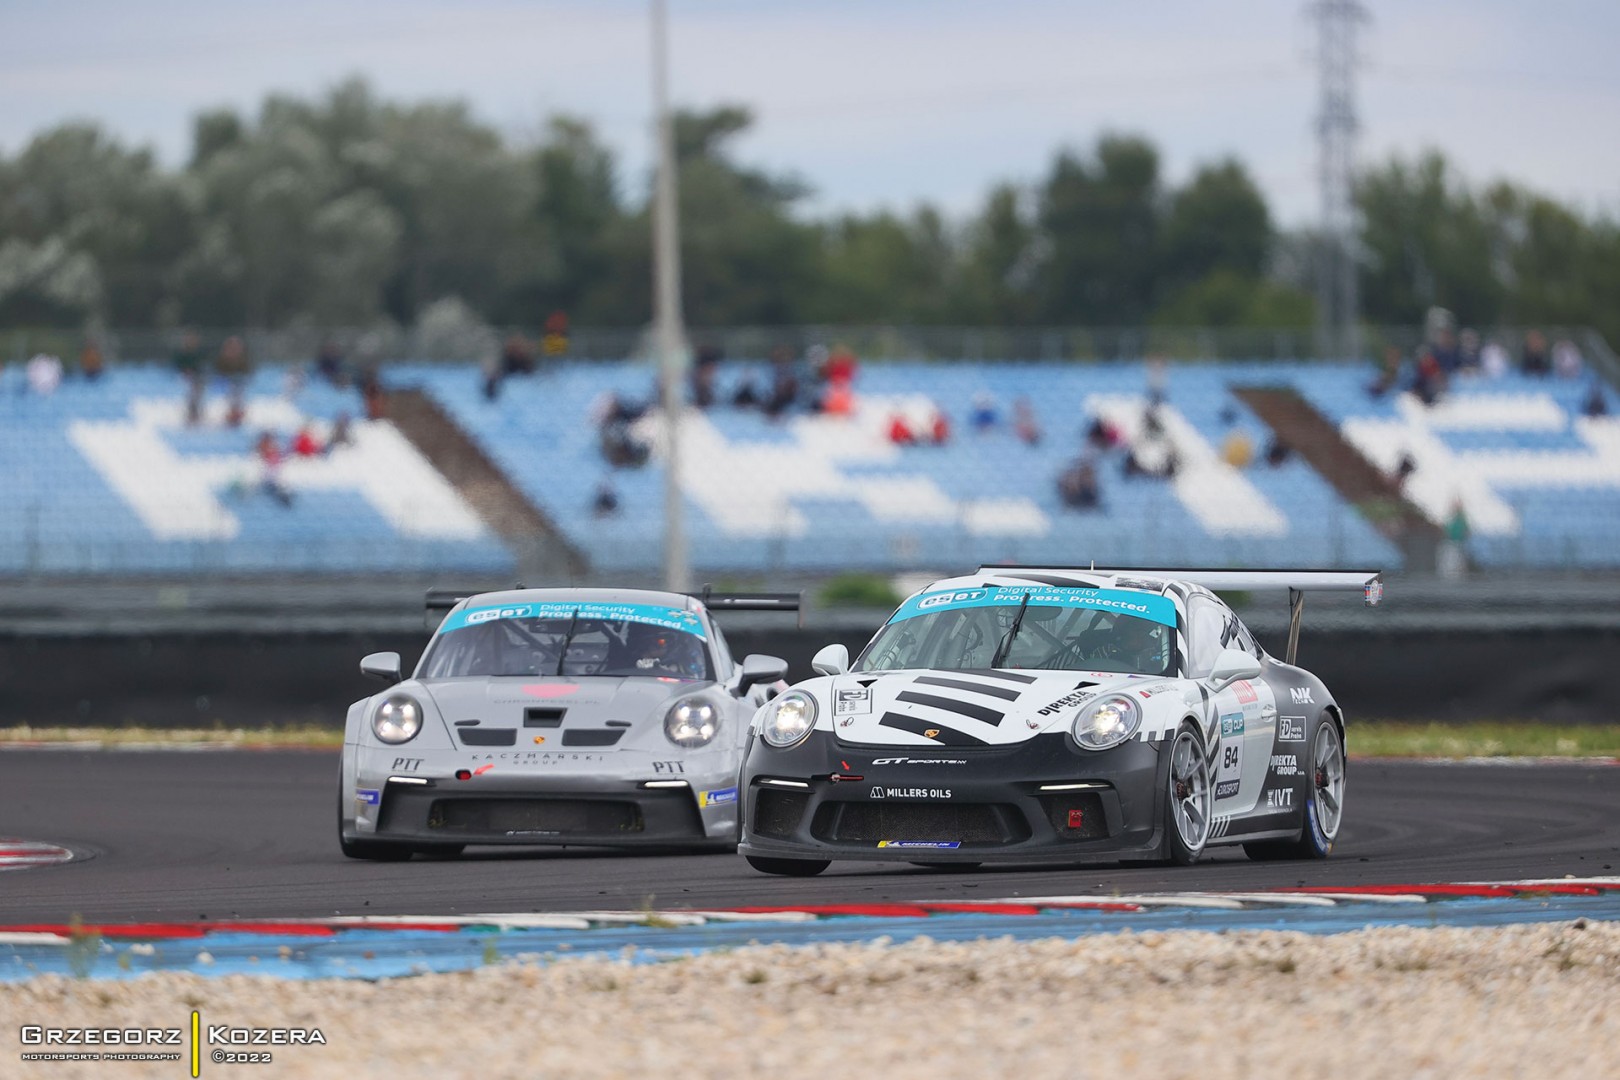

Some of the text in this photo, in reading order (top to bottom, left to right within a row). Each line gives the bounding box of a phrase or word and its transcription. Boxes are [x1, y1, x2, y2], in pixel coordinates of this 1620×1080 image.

[999, 586, 1099, 596] Digital Security
[585, 605, 636, 613] Security
[994, 594, 1150, 613] Progress. Protected.
[609, 612, 686, 630] Protected.
[1290, 687, 1315, 704] NK
[1037, 691, 1089, 716] DIREKTA
[1233, 720, 1243, 730] CUP
[392, 757, 425, 770] PTT
[471, 753, 603, 761] KACZMARSKI
[872, 757, 909, 765] GT
[1224, 746, 1239, 769] 84
[652, 760, 685, 773] PTT
[1277, 766, 1297, 776] GROUP
[887, 788, 952, 799] MILLERS OILS
[1275, 788, 1293, 807] IVT
